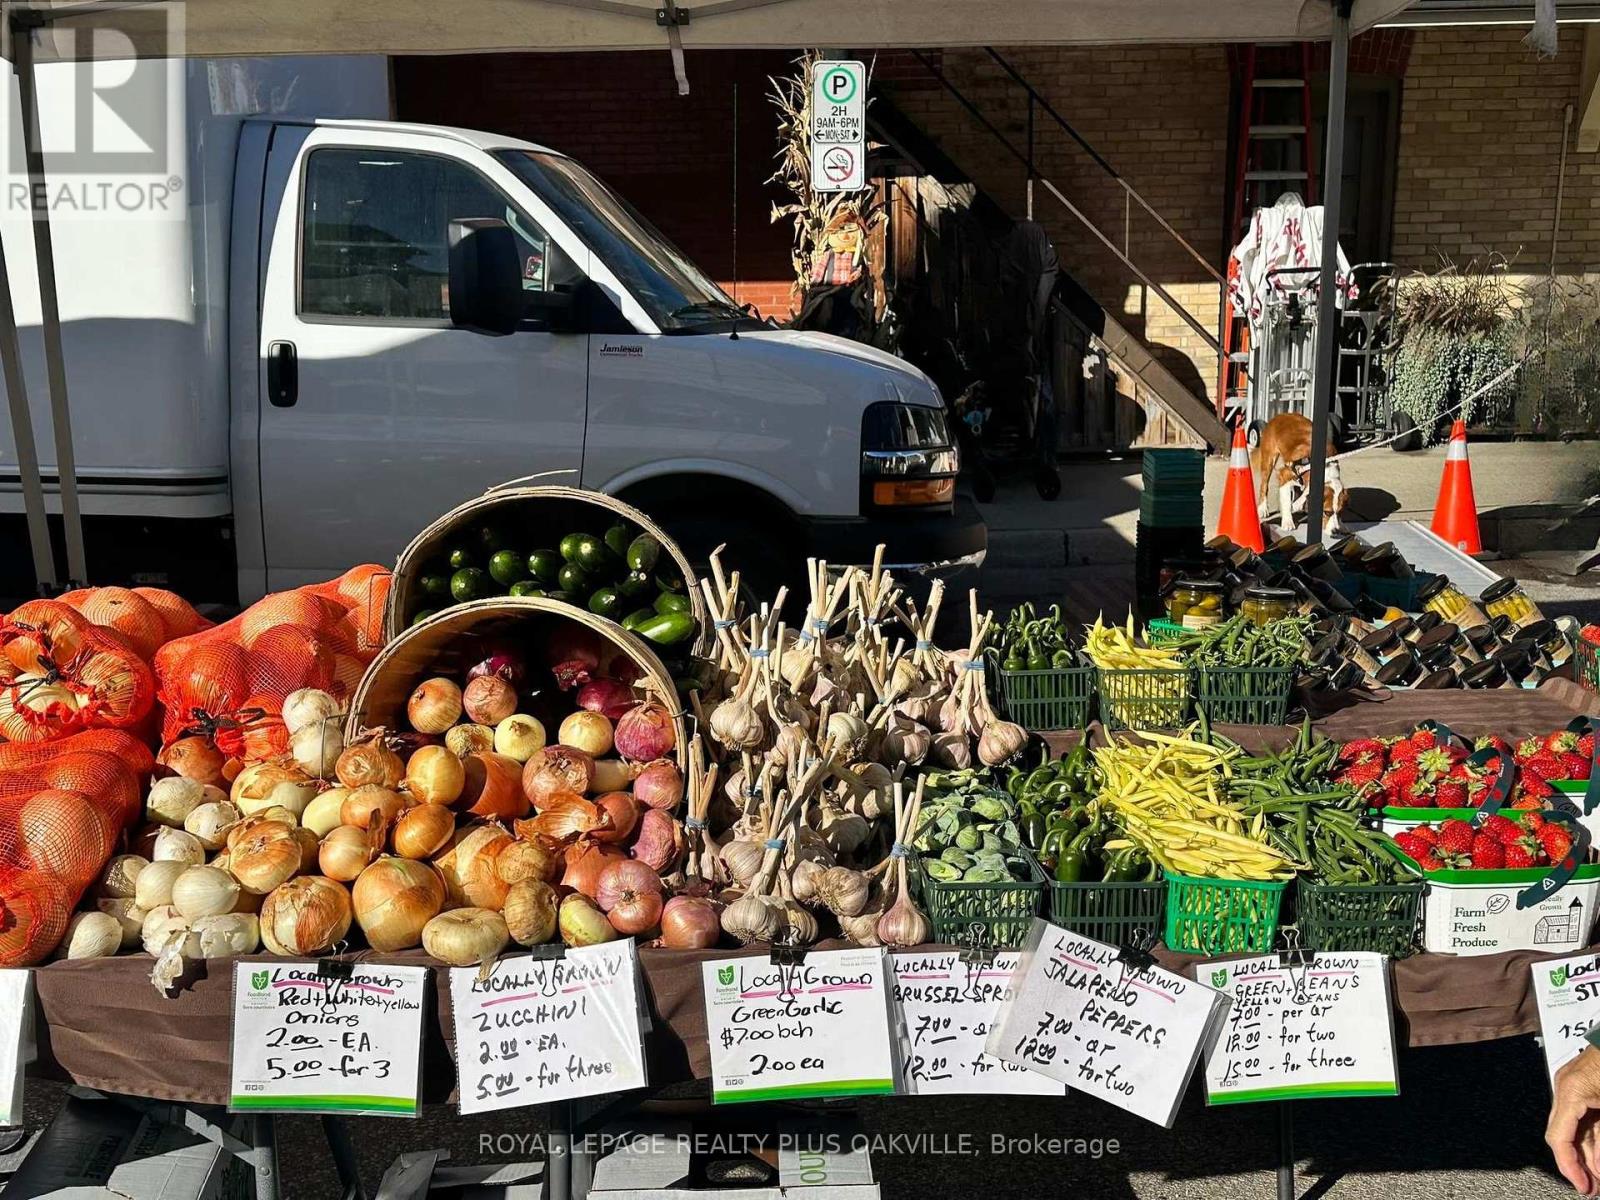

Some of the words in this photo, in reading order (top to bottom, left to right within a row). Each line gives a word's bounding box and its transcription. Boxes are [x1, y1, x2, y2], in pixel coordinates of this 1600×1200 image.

[833, 75, 847, 94] P
[831, 106, 847, 116] 2H
[600, 344, 642, 353] Jamieson
[1455, 907, 1486, 918] Farm
[1453, 922, 1486, 932] Fresh
[1054, 935, 1121, 968] LOCALLY
[1452, 937, 1499, 948] Produce
[893, 957, 956, 974] LOCALLY
[1233, 959, 1281, 977] LOCAL
[1307, 958, 1360, 971] ROWN
[803, 966, 873, 986] Grown
[1235, 980, 1286, 998] GREEN
[472, 996, 586, 1032] ZUCCHINI
[1282, 1009, 1303, 1024] per
[1279, 1026, 1301, 1046] for
[1306, 1022, 1336, 1042] two
[373, 1059, 391, 1079] 3
[565, 1054, 613, 1082] three
[800, 1057, 825, 1070] ea
[971, 1053, 994, 1076] for
[1282, 1052, 1301, 1073] for
[1307, 1047, 1356, 1068] three
[1078, 1056, 1103, 1082] for
[1106, 1064, 1135, 1096] two
